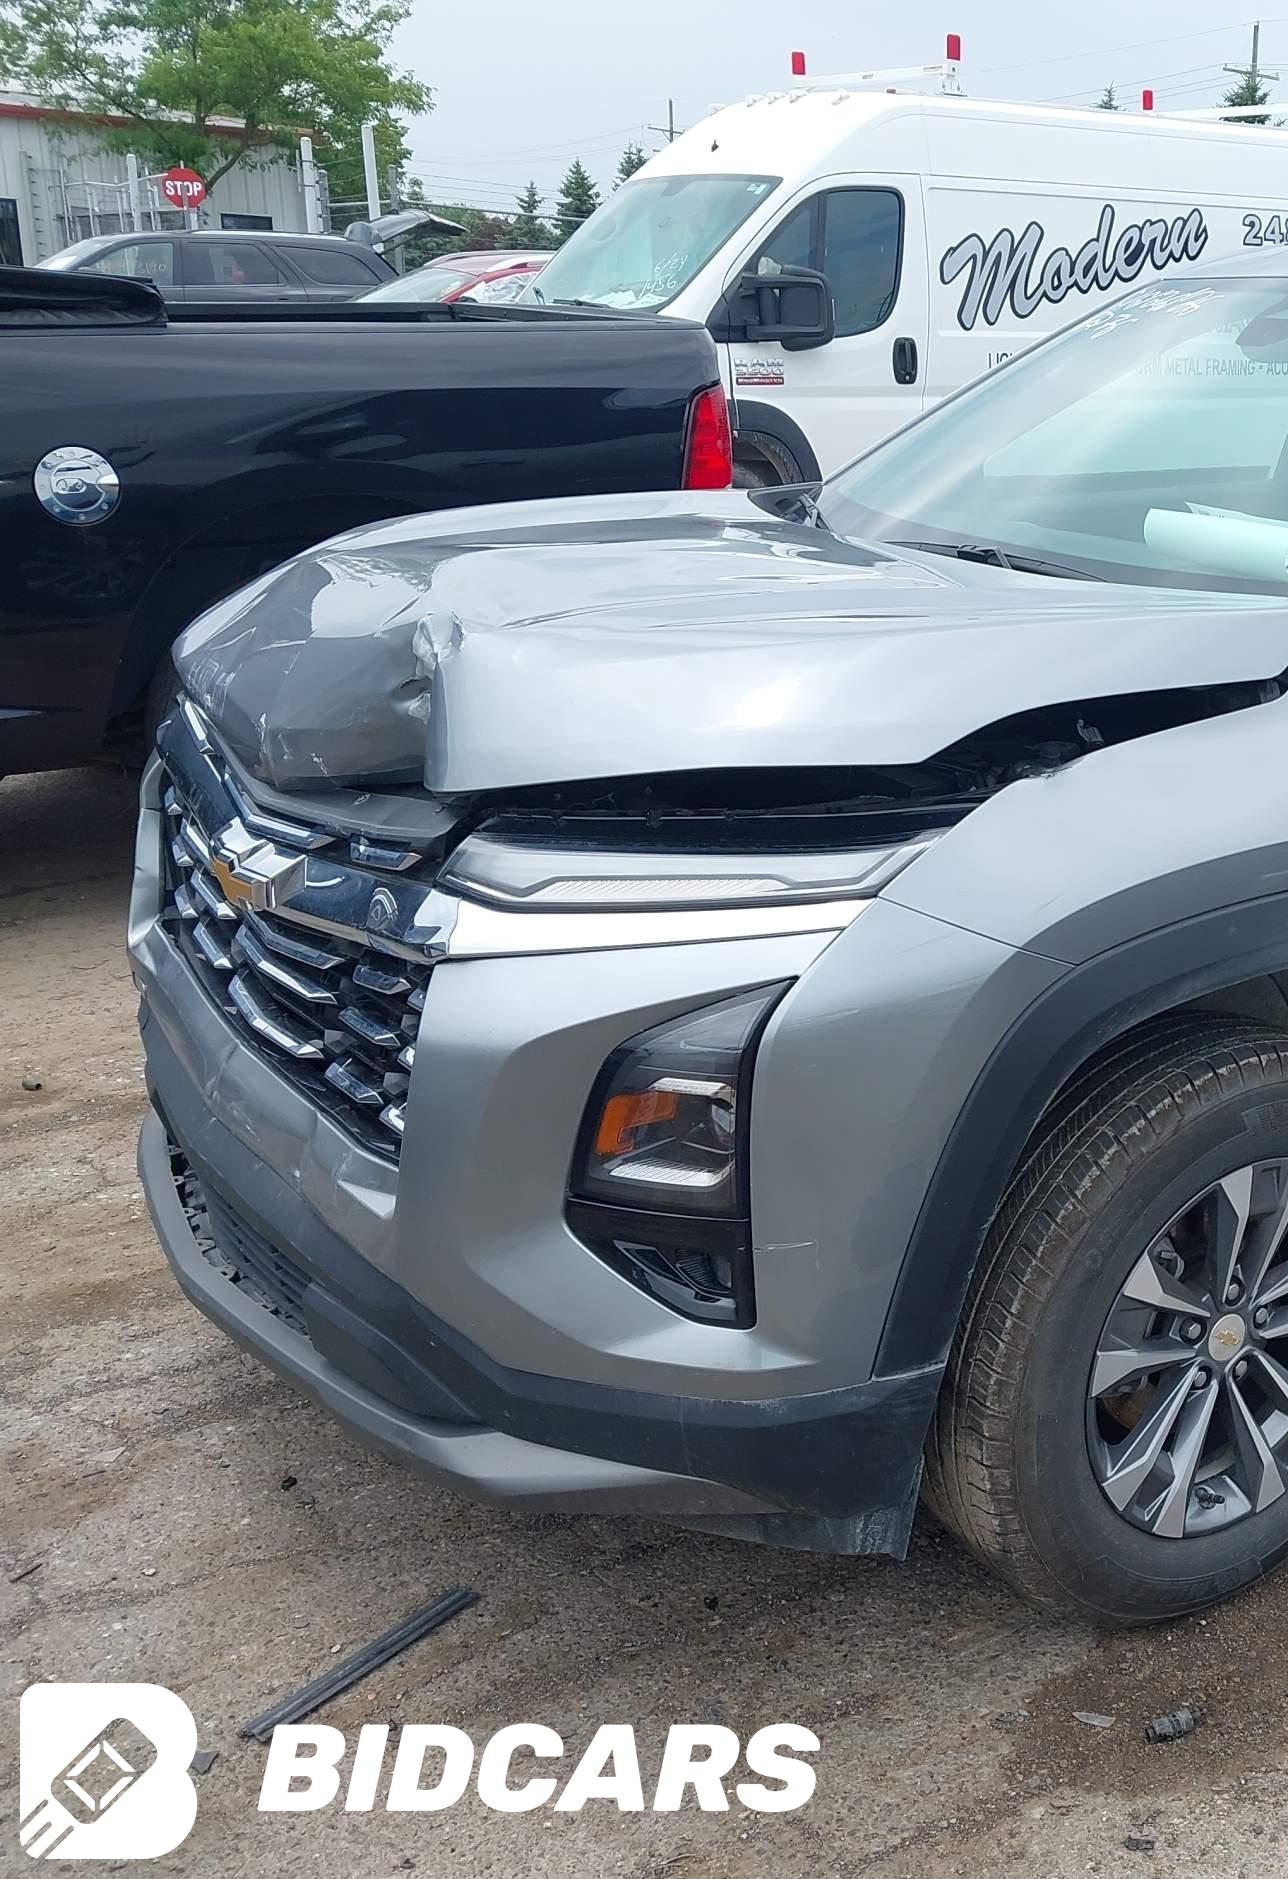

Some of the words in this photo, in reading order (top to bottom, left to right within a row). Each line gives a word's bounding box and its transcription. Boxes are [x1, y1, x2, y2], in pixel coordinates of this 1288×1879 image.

[165, 180, 202, 197] STOP
[940, 203, 1209, 331] Modern
[734, 358, 784, 367] RAM
[1166, 358, 1201, 375] METAL
[1206, 358, 1255, 376] FRAMING
